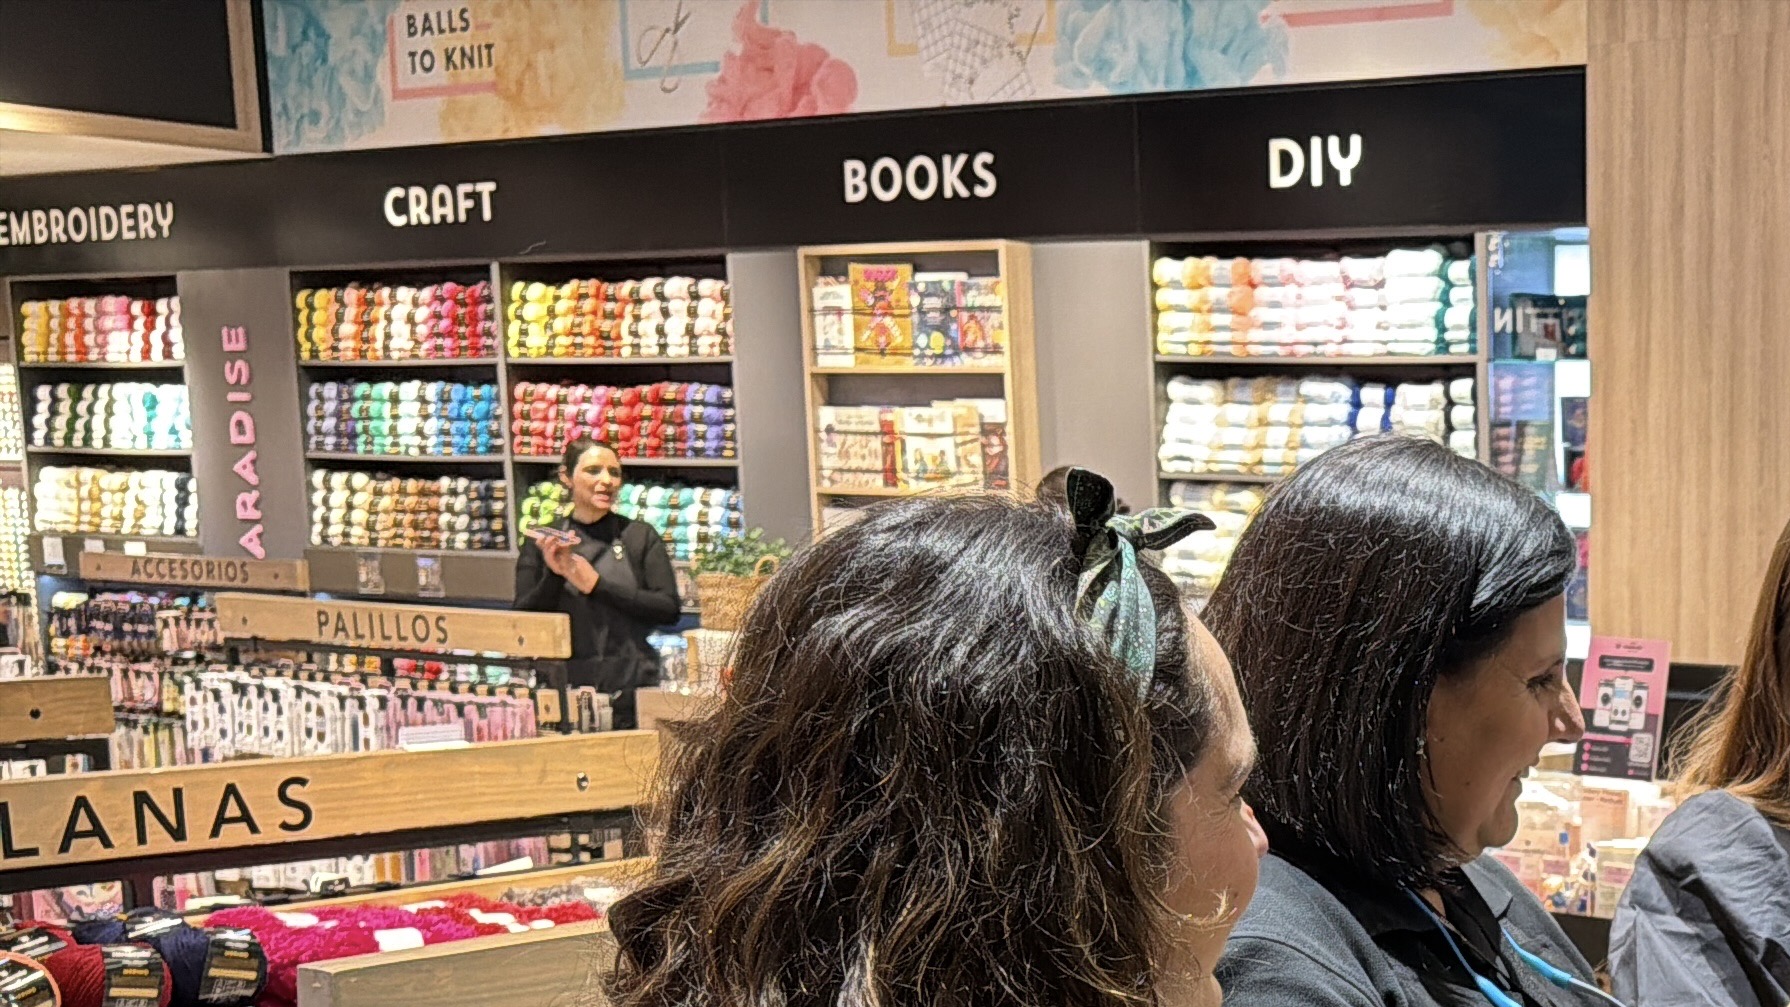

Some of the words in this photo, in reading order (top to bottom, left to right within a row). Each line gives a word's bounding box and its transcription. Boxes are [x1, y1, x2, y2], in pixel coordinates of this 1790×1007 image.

[406, 7, 470, 38] BALLS
[408, 49, 435, 75] TO
[444, 43, 495, 72] KNIT
[843, 151, 997, 203] BOOKS
[1269, 134, 1362, 188] DIY
[0, 201, 174, 246] EMBROIDERY
[384, 181, 497, 227] CRAFT
[130, 558, 249, 584] ACCESORIOS
[317, 608, 449, 645] PALILLOS
[0, 775, 314, 860] LANAS
